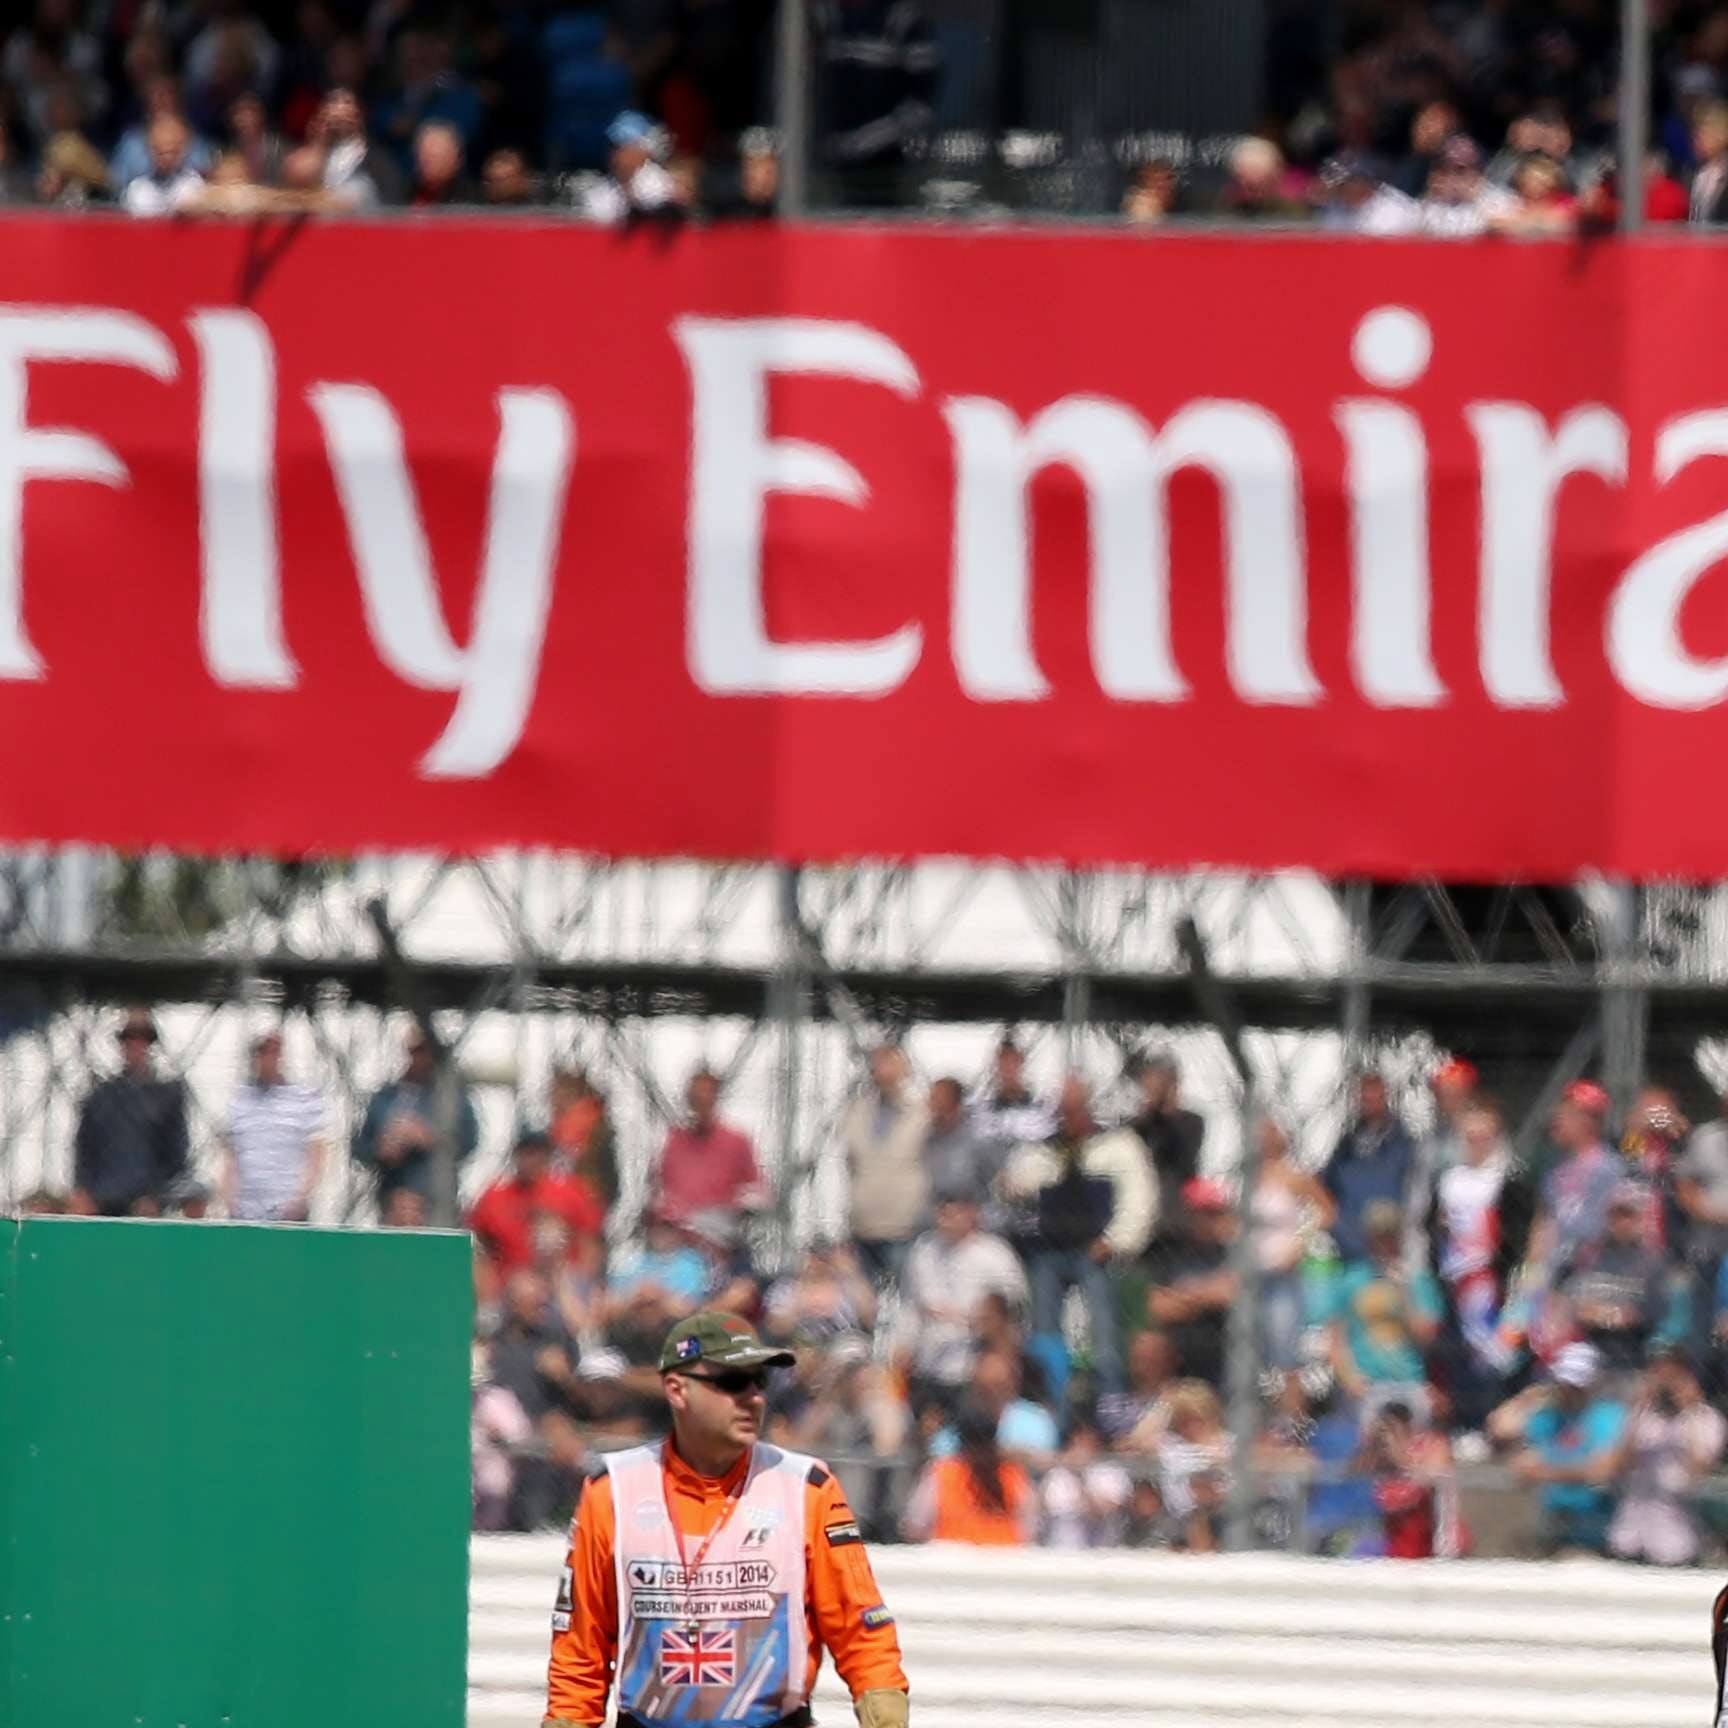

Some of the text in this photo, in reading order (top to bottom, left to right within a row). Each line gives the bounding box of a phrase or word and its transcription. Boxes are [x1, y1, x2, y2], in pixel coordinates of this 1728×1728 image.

[0, 303, 574, 778] Fly
[740, 1566, 769, 1583] 2014
[721, 1598, 768, 1612] MARSHAL
